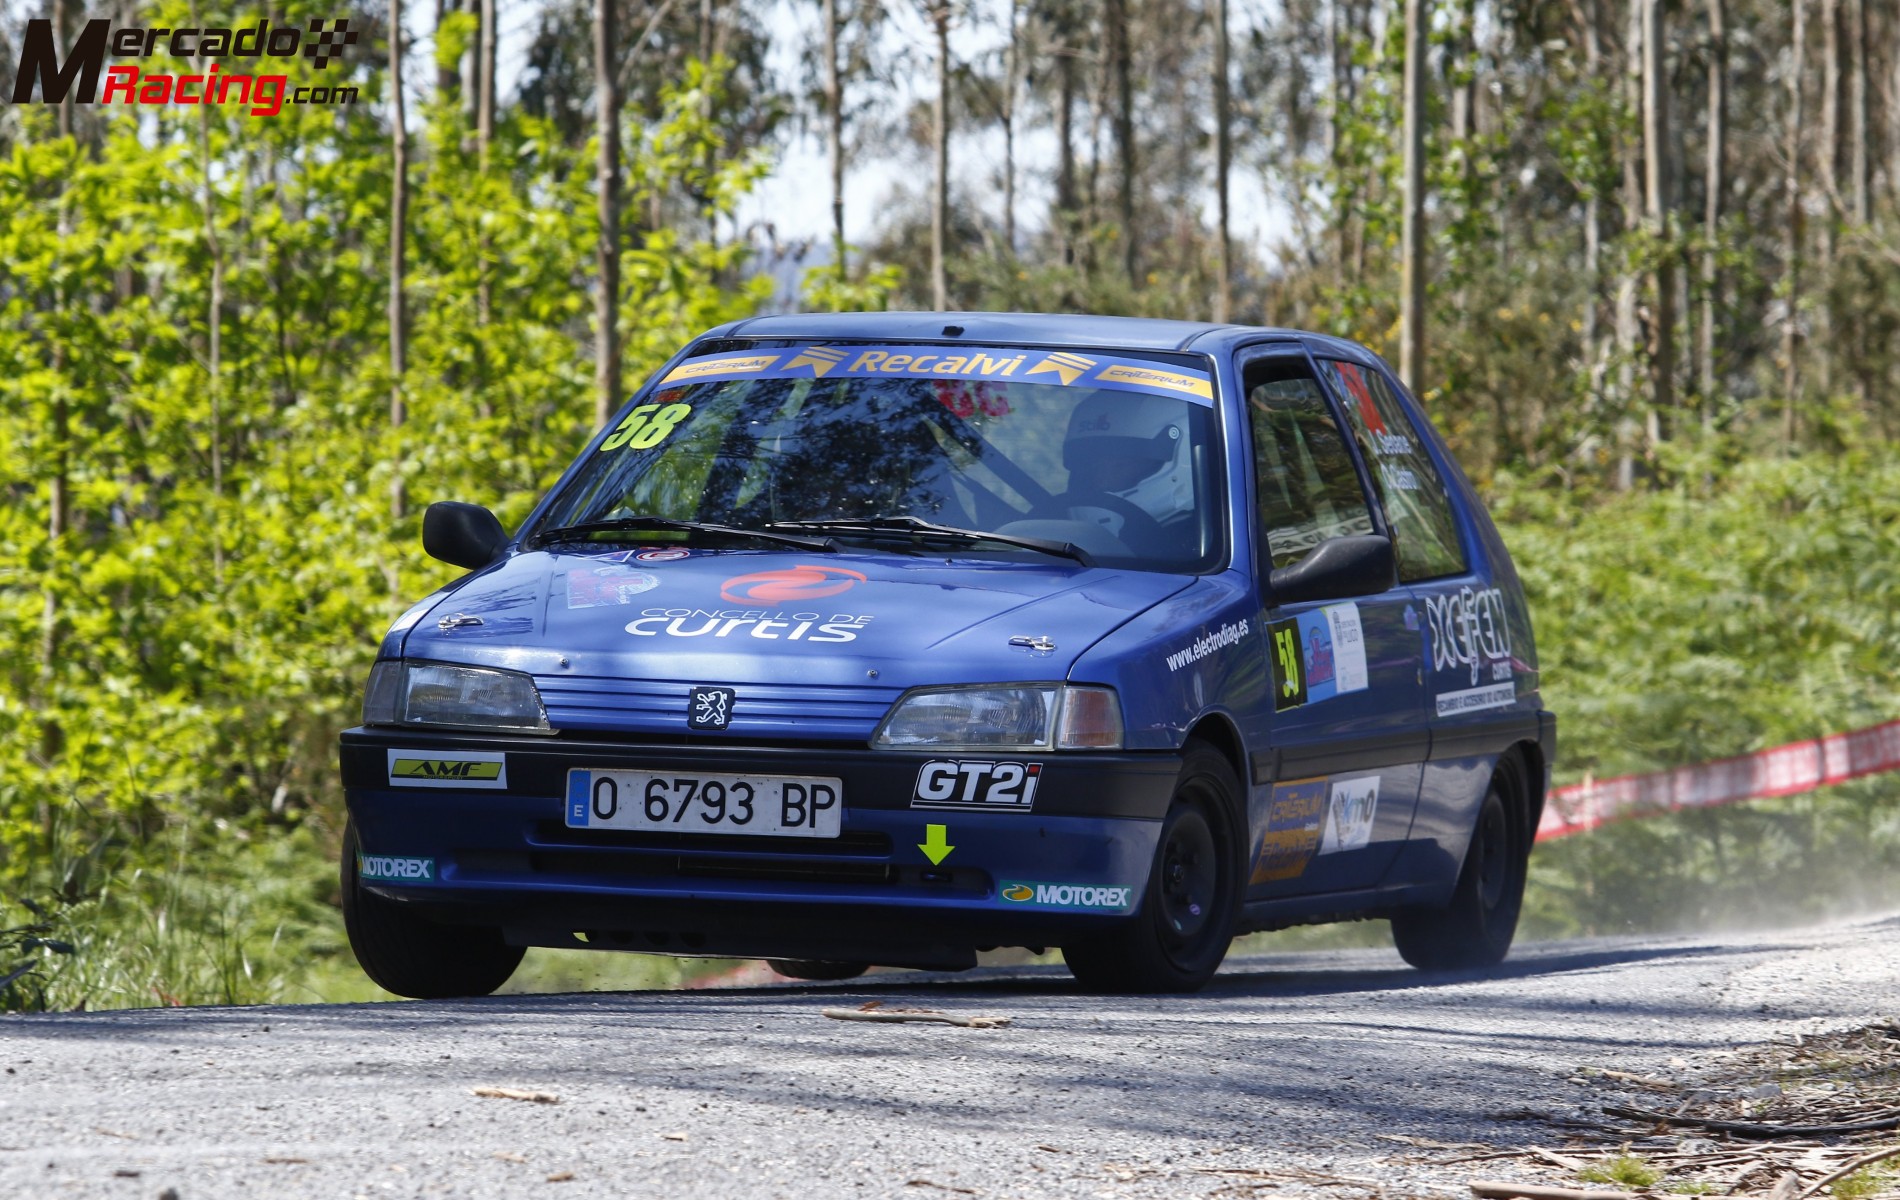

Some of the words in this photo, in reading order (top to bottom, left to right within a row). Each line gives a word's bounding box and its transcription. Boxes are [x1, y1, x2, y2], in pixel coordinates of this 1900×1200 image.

[847, 350, 1027, 377] Recalvi
[1109, 369, 1195, 388] CRITERIUM
[599, 403, 692, 452] 58
[640, 607, 820, 621] CONCELLO
[829, 613, 875, 626] DE
[1166, 618, 1249, 672] www.electrodiag.es
[1274, 628, 1300, 698] 58
[410, 761, 481, 776] AMF
[916, 762, 1041, 804] GT2i
[573, 805, 584, 817] E
[644, 778, 755, 826] 6793
[780, 782, 836, 829] BP
[361, 855, 431, 879] MOTOREX
[1036, 884, 1129, 907] MOTOREX
